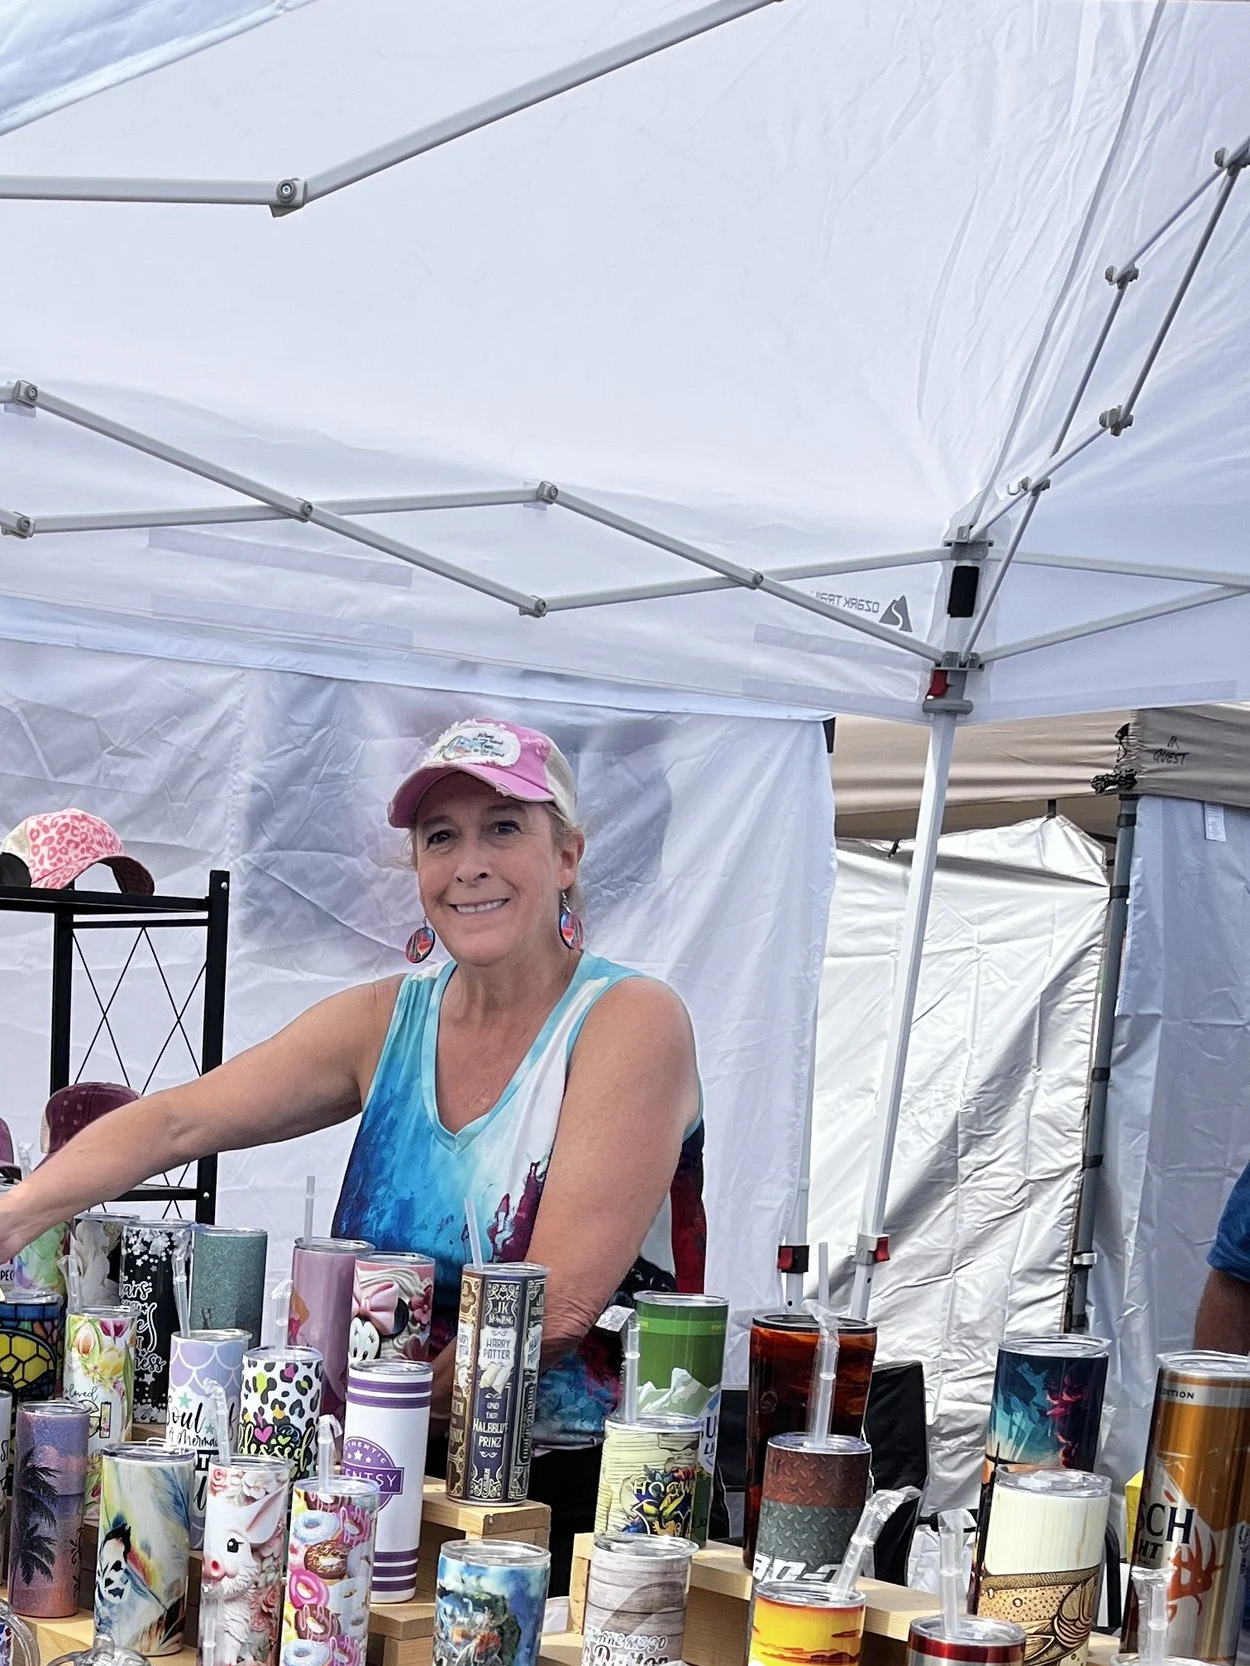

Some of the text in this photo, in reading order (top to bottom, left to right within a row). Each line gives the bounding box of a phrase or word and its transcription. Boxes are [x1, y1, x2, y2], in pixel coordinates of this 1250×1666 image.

[486, 1337, 511, 1349] HARRY
[483, 1348, 510, 1360] POTTER
[478, 1435, 502, 1448] PRINZ
[343, 1466, 398, 1488] ENTSY
